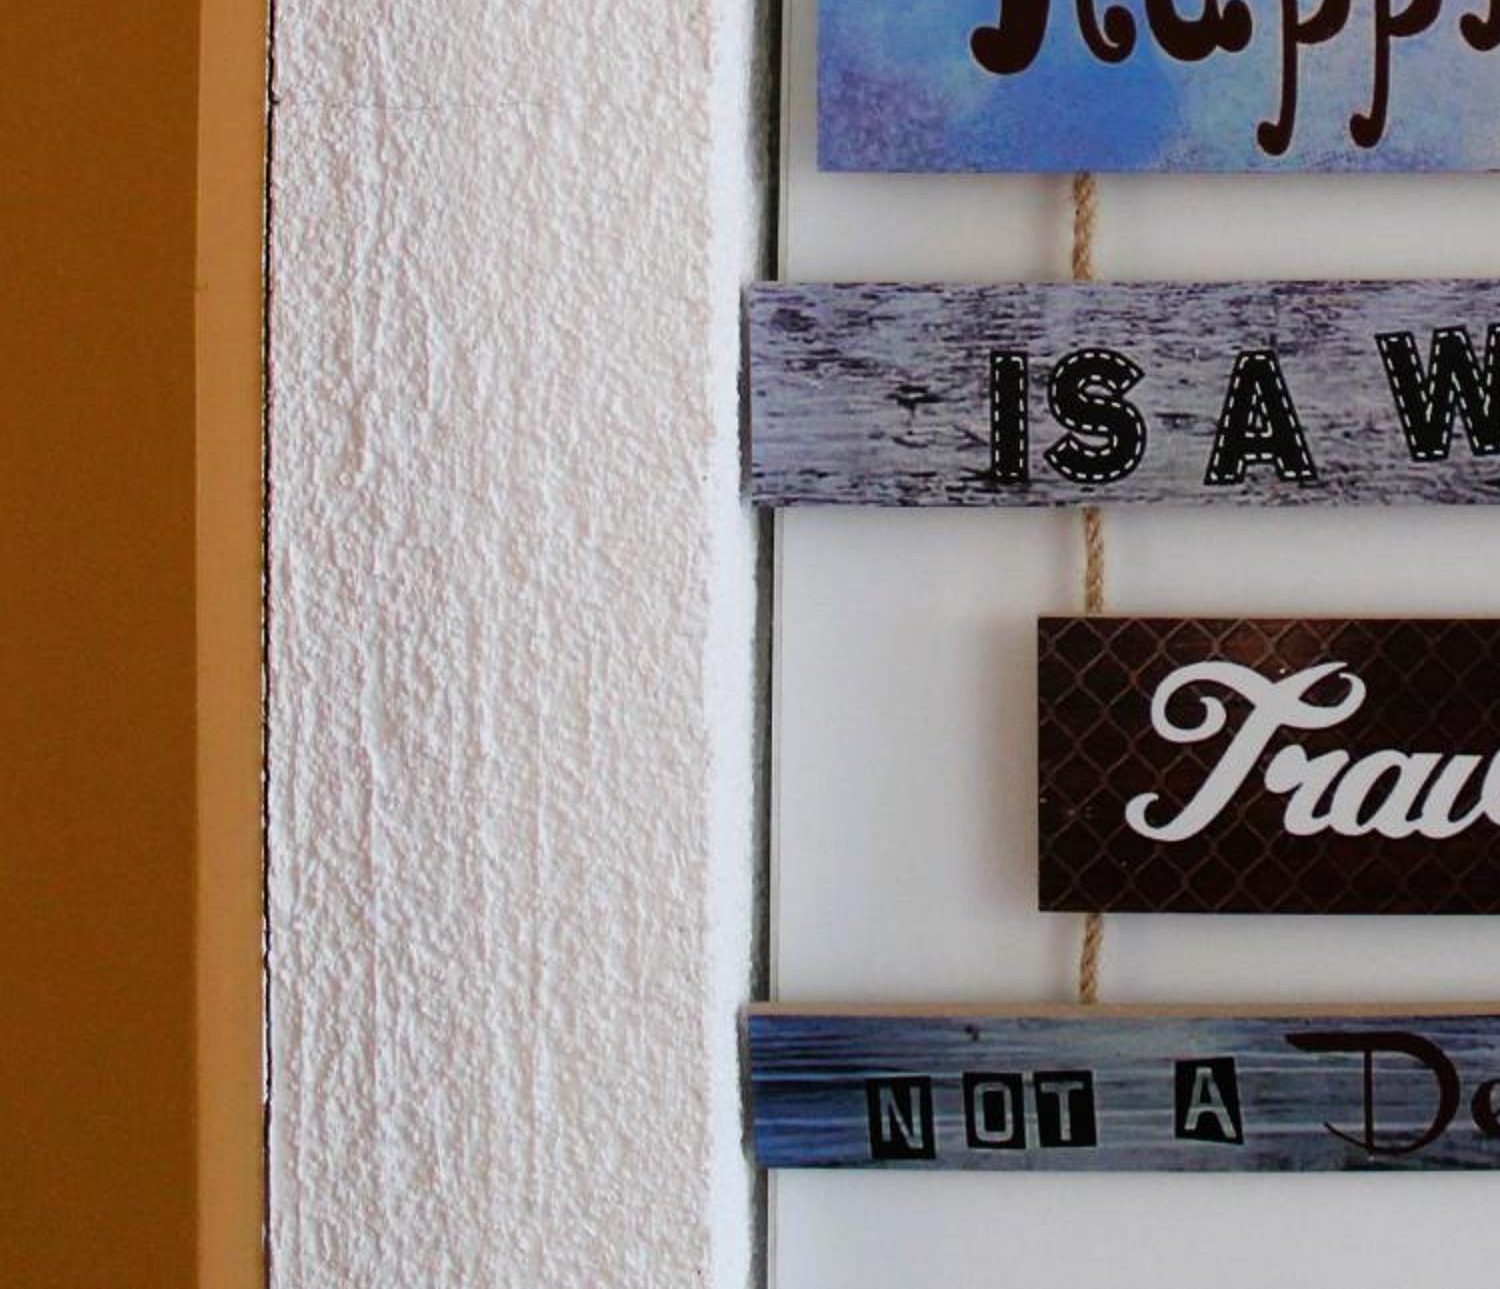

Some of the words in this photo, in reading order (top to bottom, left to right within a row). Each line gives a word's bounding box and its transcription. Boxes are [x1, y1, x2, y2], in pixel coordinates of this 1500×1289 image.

[989, 346, 1147, 484] IS
[1203, 348, 1318, 486] A
[878, 1082, 1085, 1151] NOT
[1183, 1066, 1238, 1141] A
